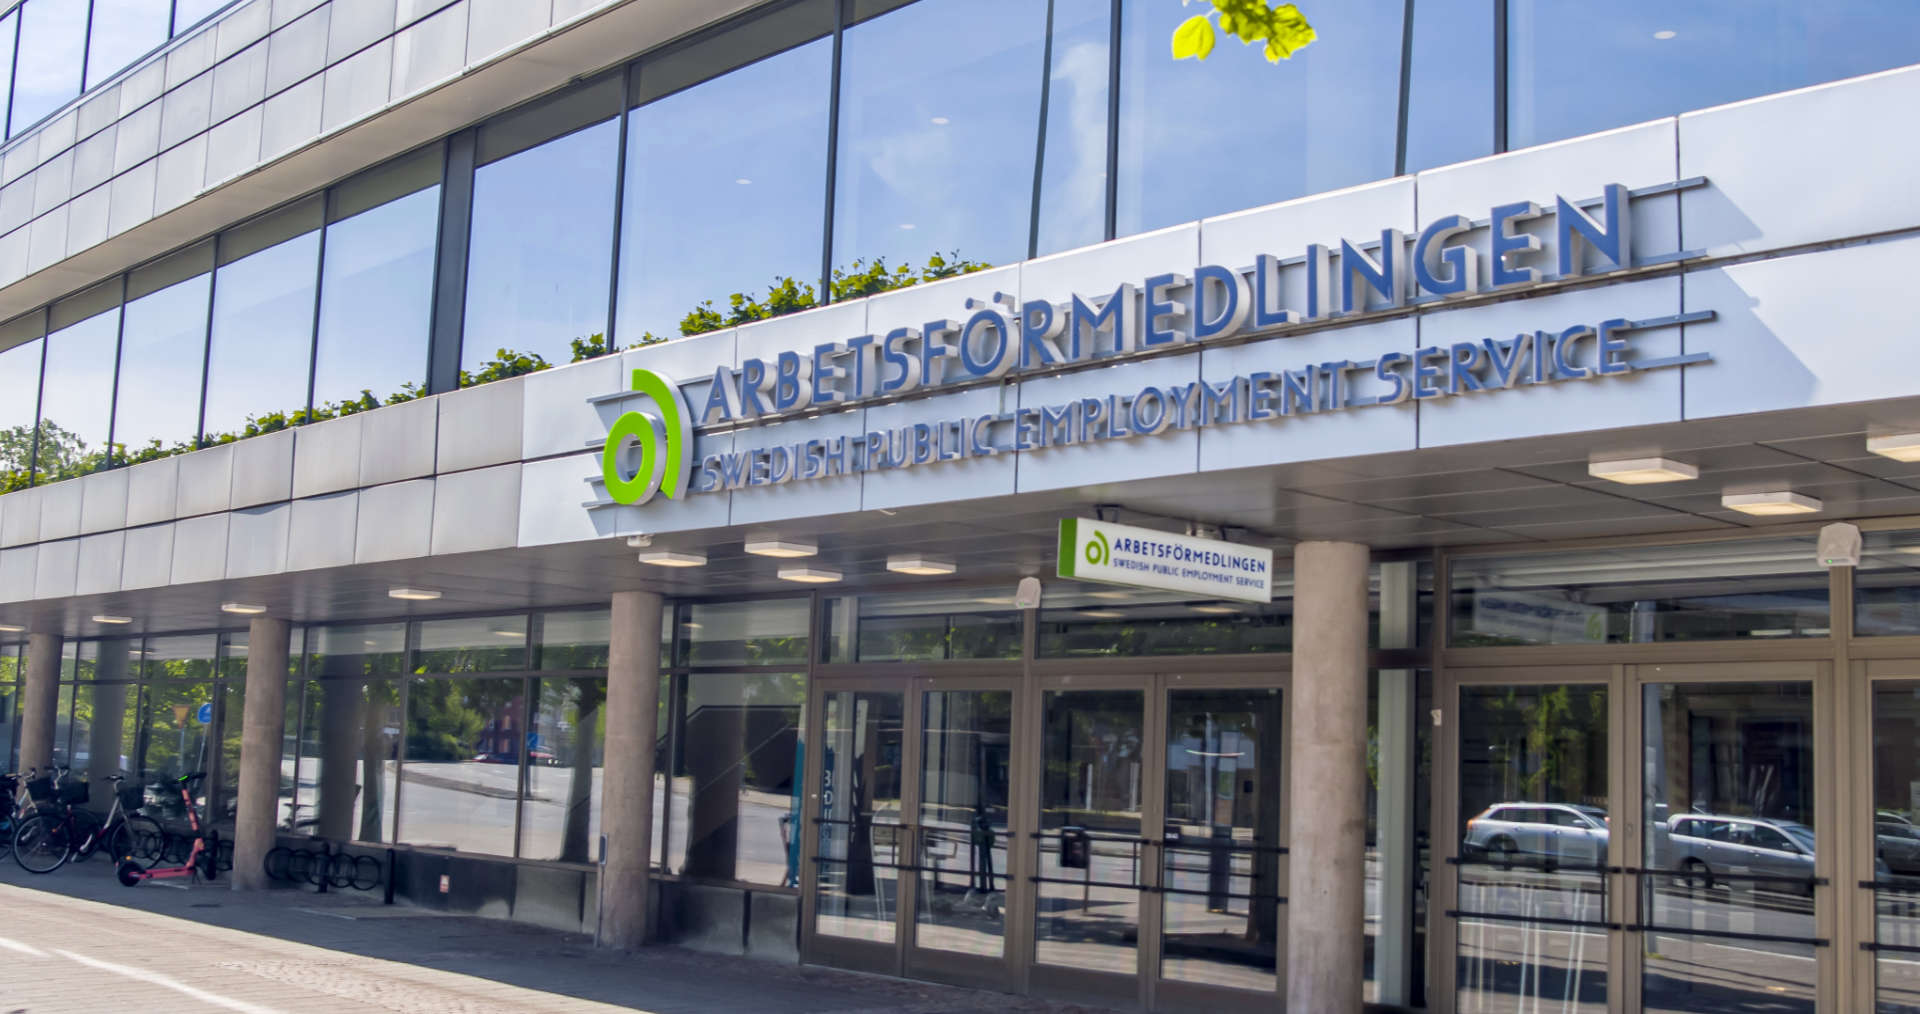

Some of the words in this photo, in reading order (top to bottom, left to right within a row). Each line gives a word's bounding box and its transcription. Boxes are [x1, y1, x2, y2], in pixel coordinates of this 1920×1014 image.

[701, 183, 1631, 424] ARBETSFÖRMEDLINGEN
[701, 435, 852, 492] SWEDISH
[864, 414, 998, 471] PUBLIC
[1015, 360, 1355, 449] EMPLOYMENT
[1375, 318, 1632, 405] SERVICE
[1113, 558, 1150, 571] SWEDISH
[1152, 564, 1178, 577] PUBLIC
[1181, 568, 1233, 585] EMPLOYMENT
[1236, 576, 1265, 589] SERVICE
[1114, 538, 1266, 573] ARBETSFÖRMEDLINGEN
